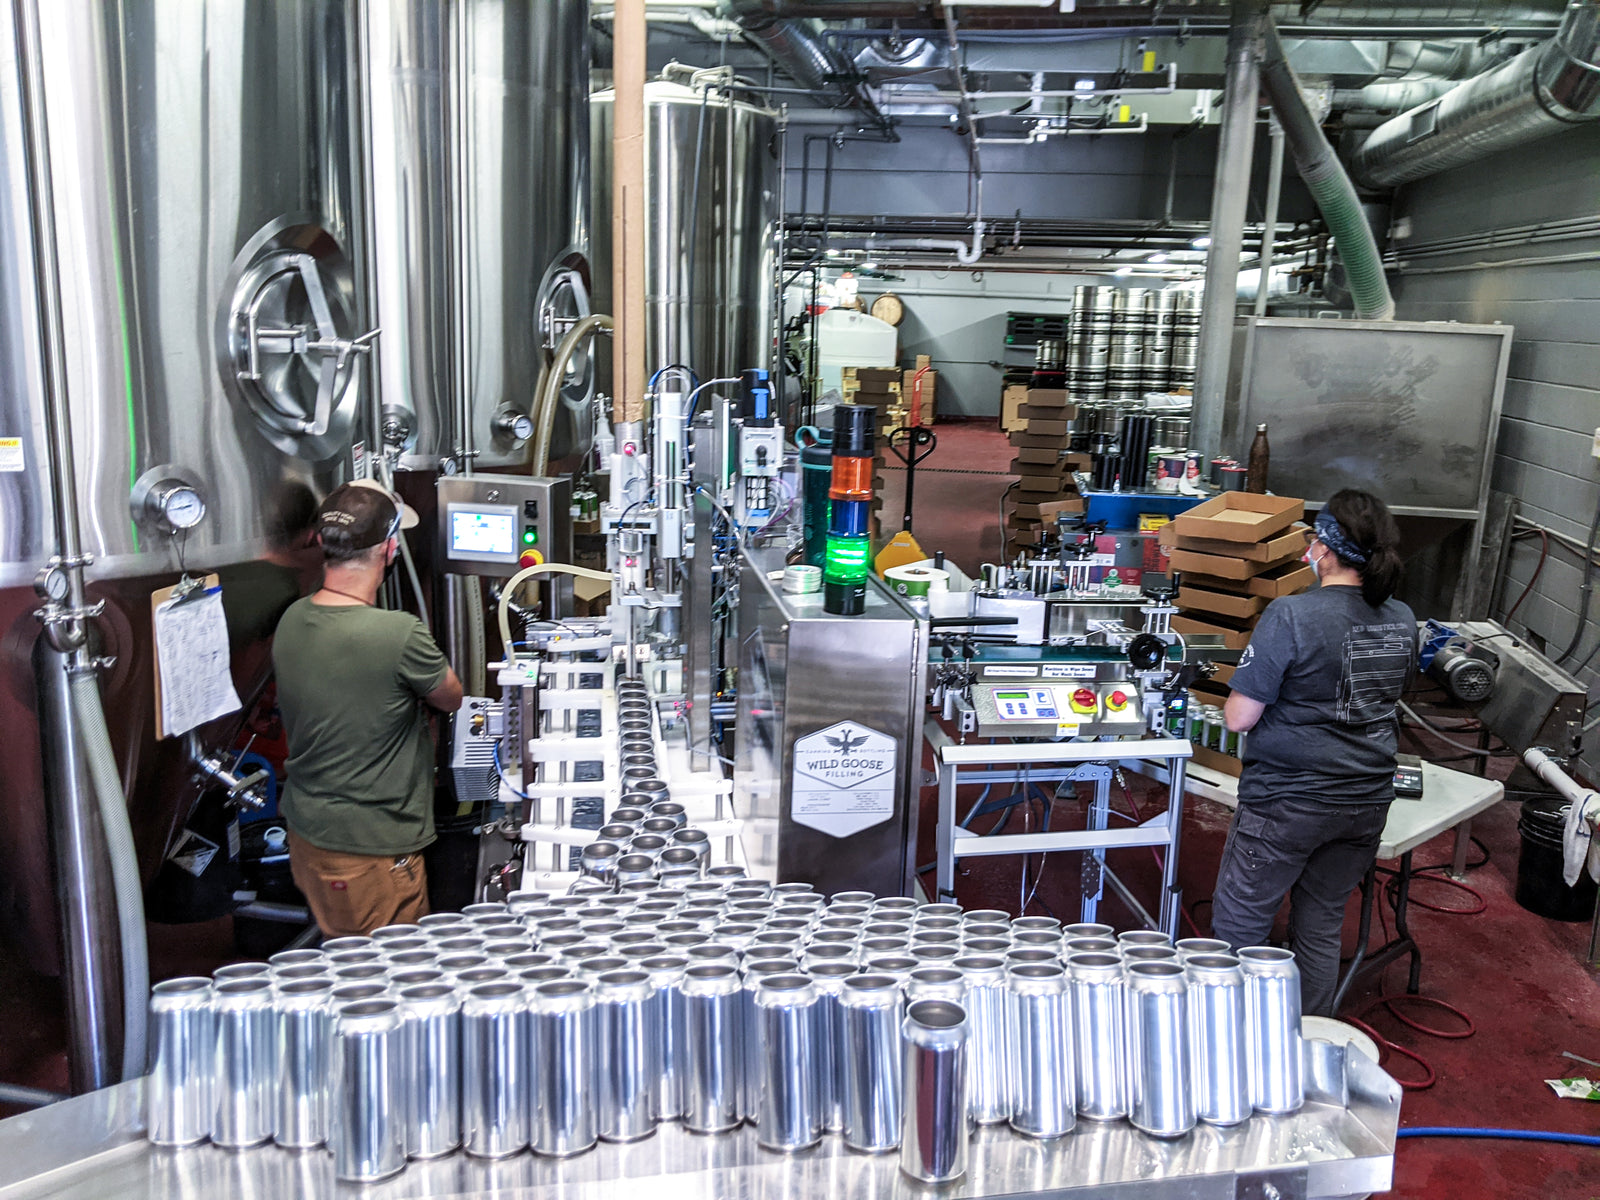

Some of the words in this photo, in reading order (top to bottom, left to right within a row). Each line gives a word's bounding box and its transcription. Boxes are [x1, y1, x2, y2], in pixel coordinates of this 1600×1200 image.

[807, 759, 839, 770] WILD
[841, 758, 884, 770] GOOSE
[825, 770, 864, 778] FILLING
